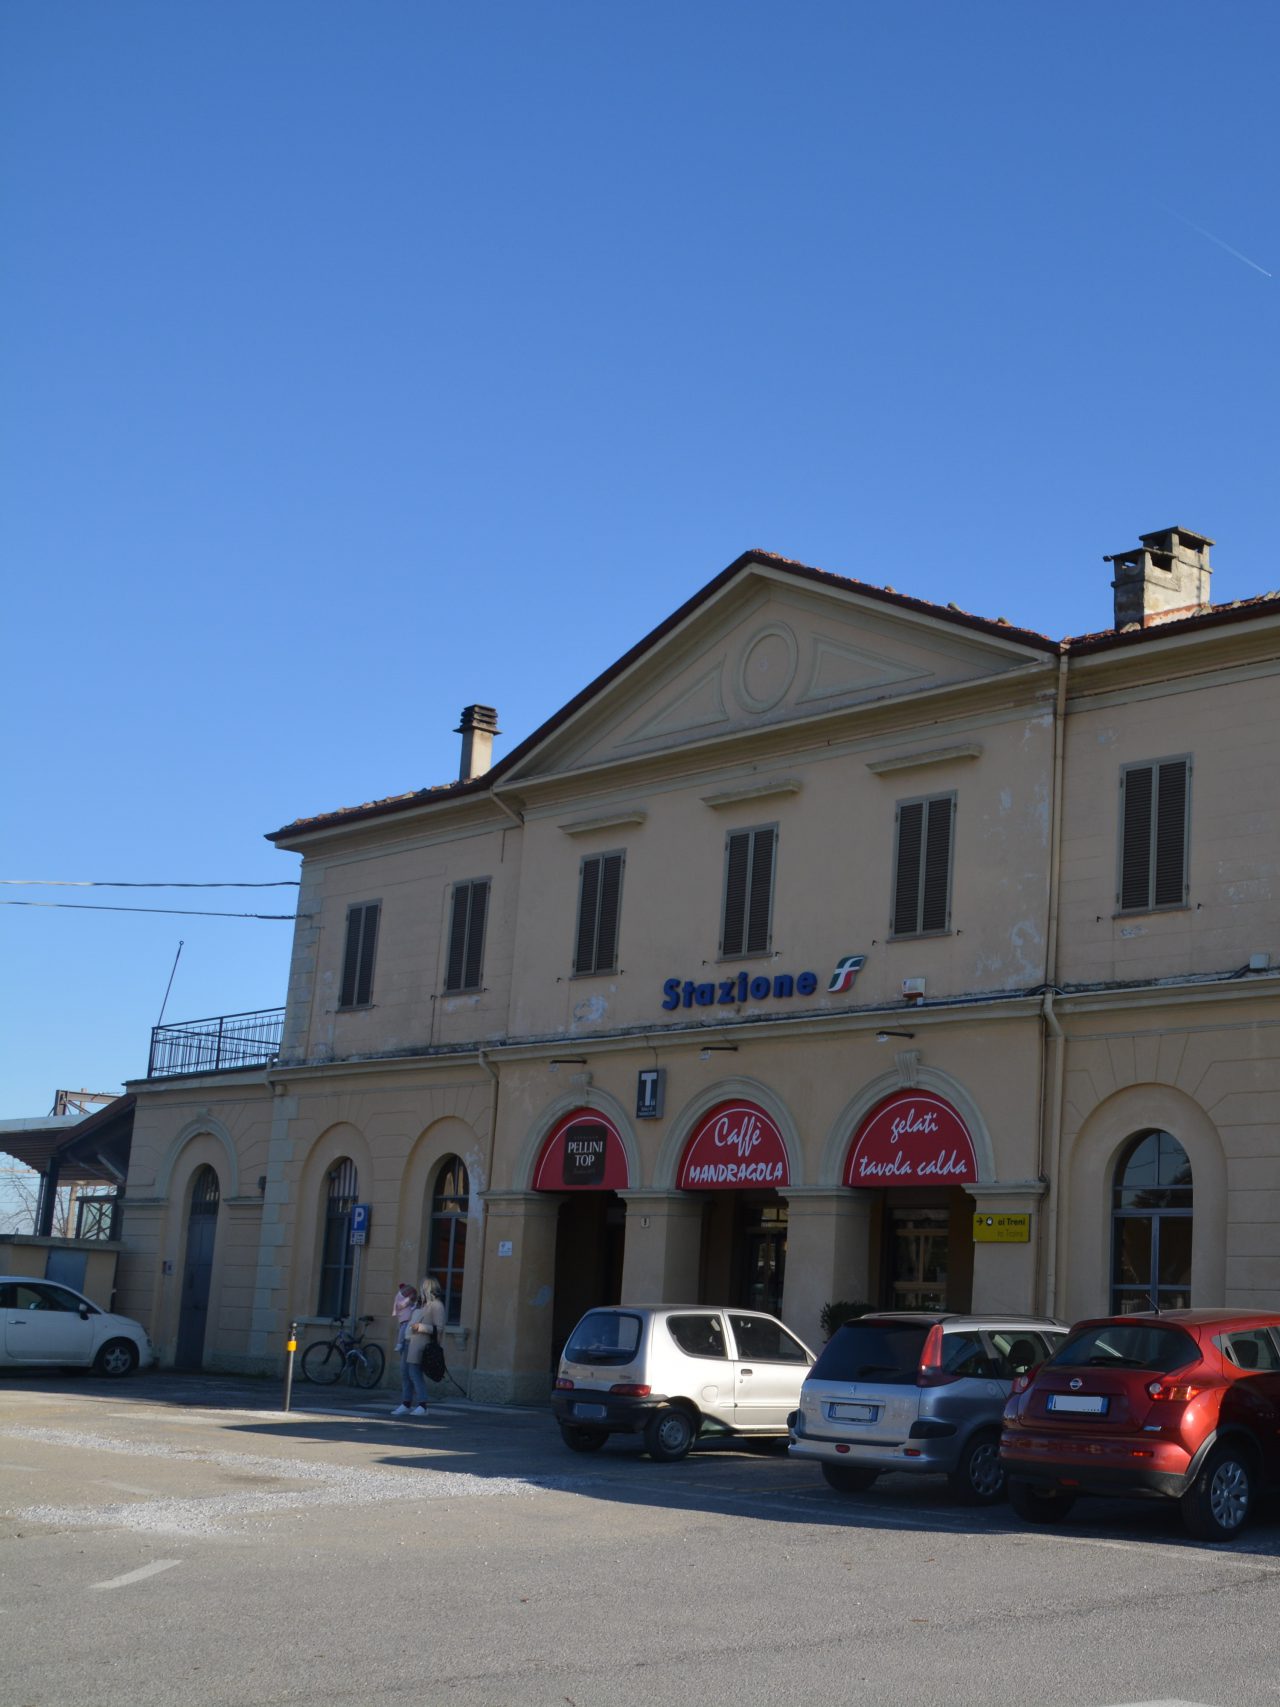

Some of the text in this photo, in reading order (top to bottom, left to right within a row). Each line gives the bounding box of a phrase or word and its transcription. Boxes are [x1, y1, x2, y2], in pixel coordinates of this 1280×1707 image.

[661, 971, 817, 1011] Stazione
[714, 1116, 762, 1157] Caffè
[890, 1108, 938, 1143] gelati
[567, 1141, 603, 1153] PELLINI
[574, 1154, 595, 1166] TOP
[859, 1150, 968, 1177] tavola calda
[688, 1161, 783, 1183] MANDRAGOLA
[354, 1207, 365, 1229] P
[997, 1217, 1026, 1226] ai Treni
